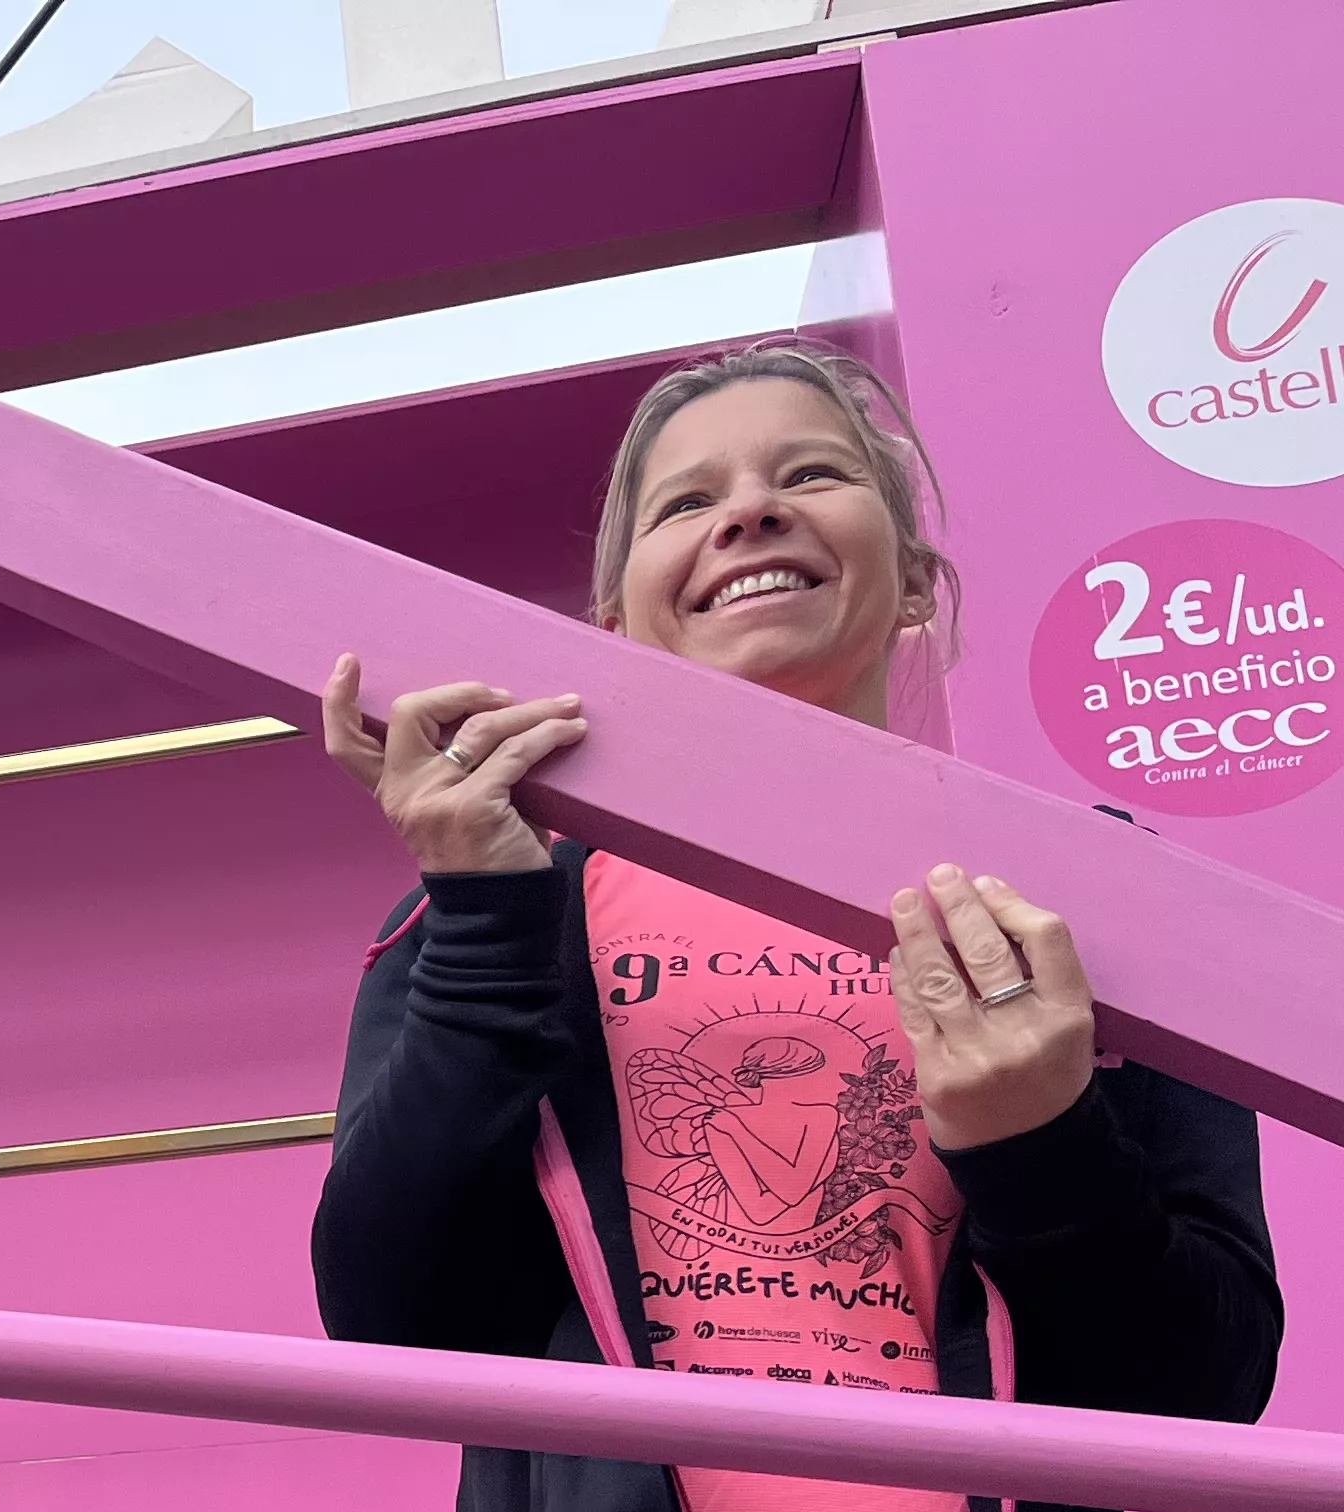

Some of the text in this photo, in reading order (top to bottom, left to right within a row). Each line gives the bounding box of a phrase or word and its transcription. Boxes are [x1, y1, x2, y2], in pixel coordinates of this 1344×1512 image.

[1083, 650, 1335, 711] a beneficio
[1106, 702, 1330, 770] aecc
[1144, 754, 1303, 784] Contra el Cáncer
[673, 935, 694, 949] EL
[829, 978, 893, 996] HU
[671, 1208, 859, 1255] EN TODAS TUS VERSIONES
